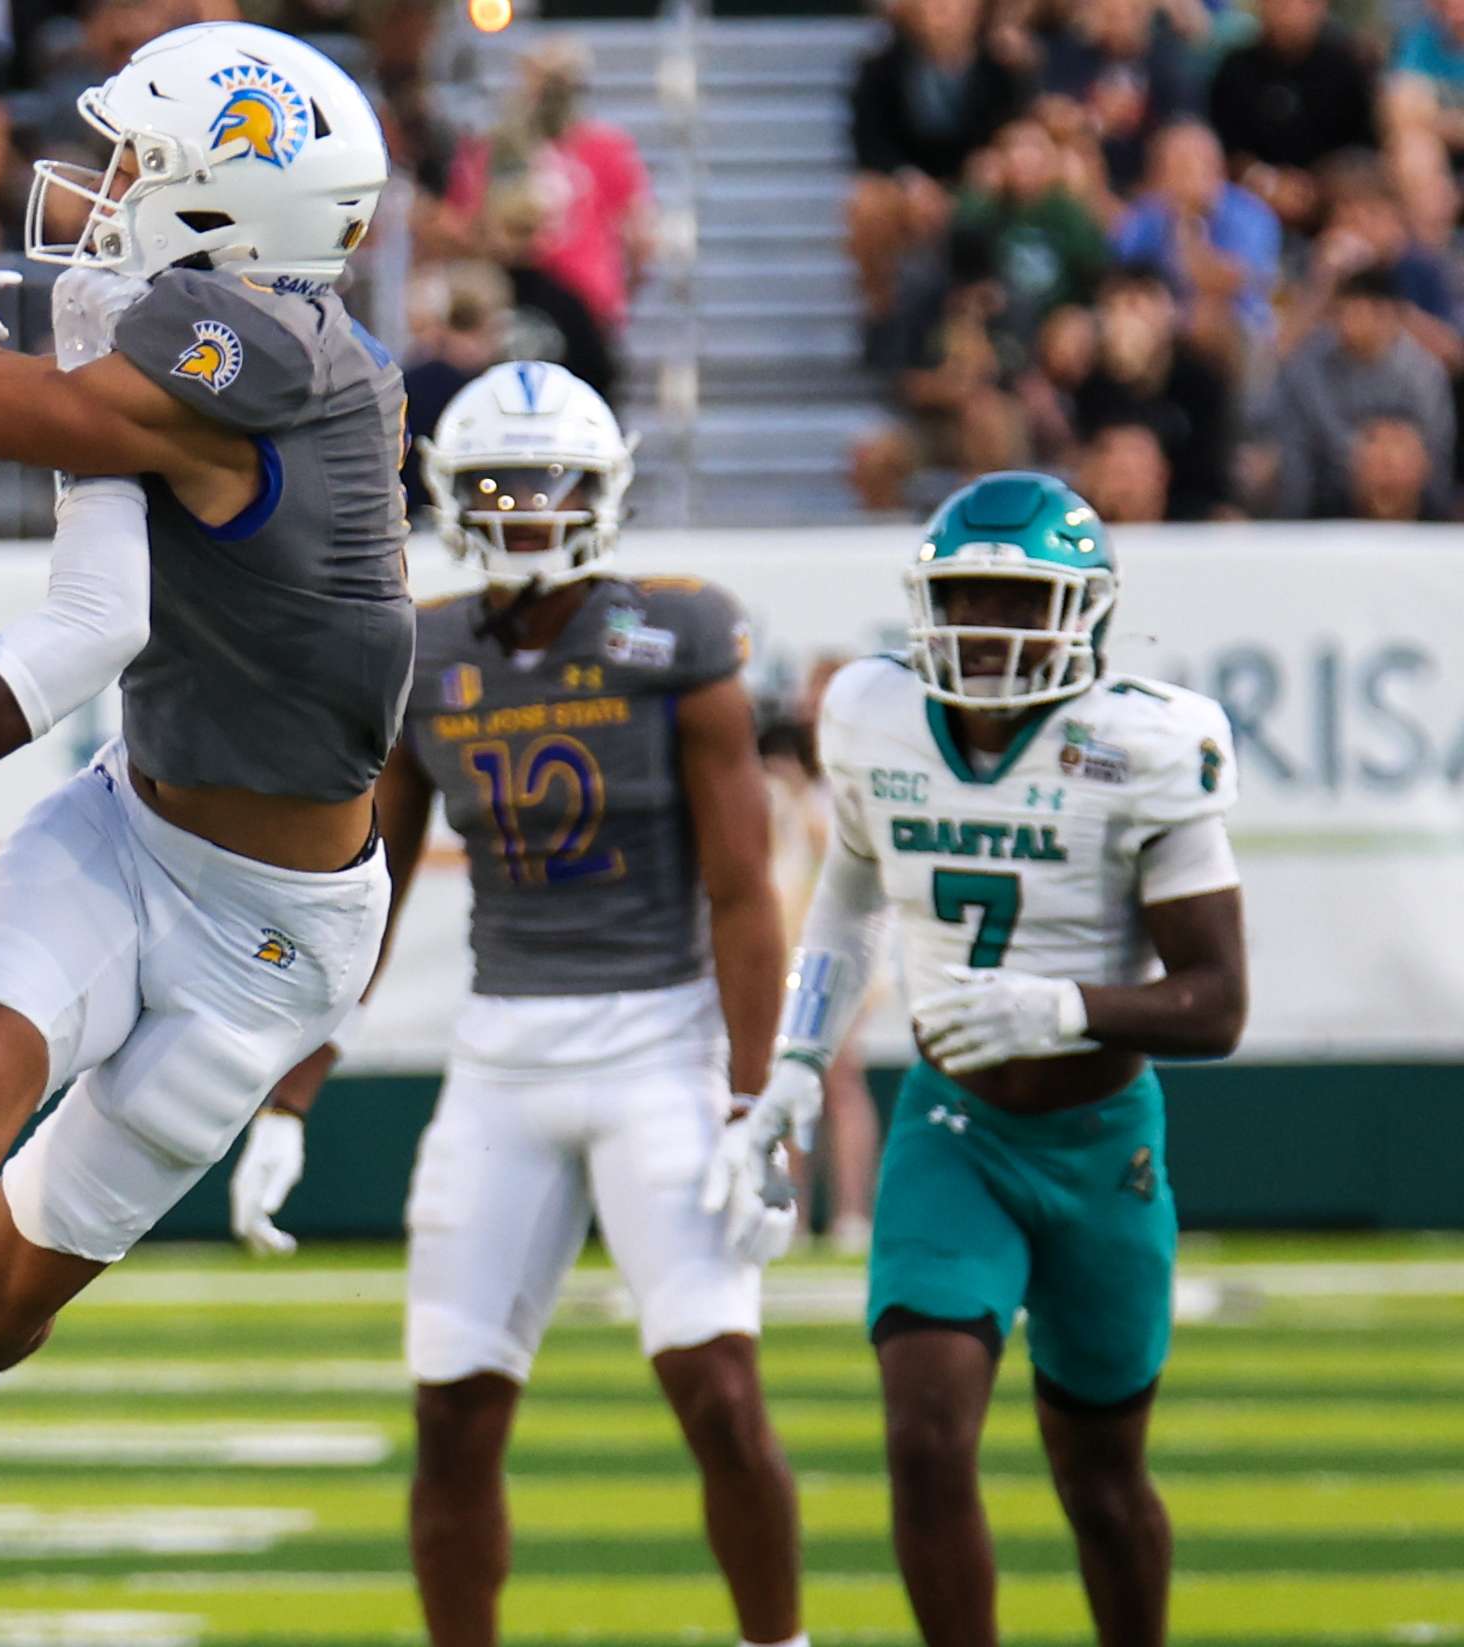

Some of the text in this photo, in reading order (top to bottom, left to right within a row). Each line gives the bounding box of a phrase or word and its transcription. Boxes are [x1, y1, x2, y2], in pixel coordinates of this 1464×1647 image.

[272, 275, 313, 296] SAN
[434, 713, 480, 740] SAN
[553, 696, 628, 729] STATE
[1168, 640, 1464, 788] RIS
[461, 734, 627, 884] 12
[891, 814, 1069, 862] COASTAL
[931, 864, 1023, 968] 7
